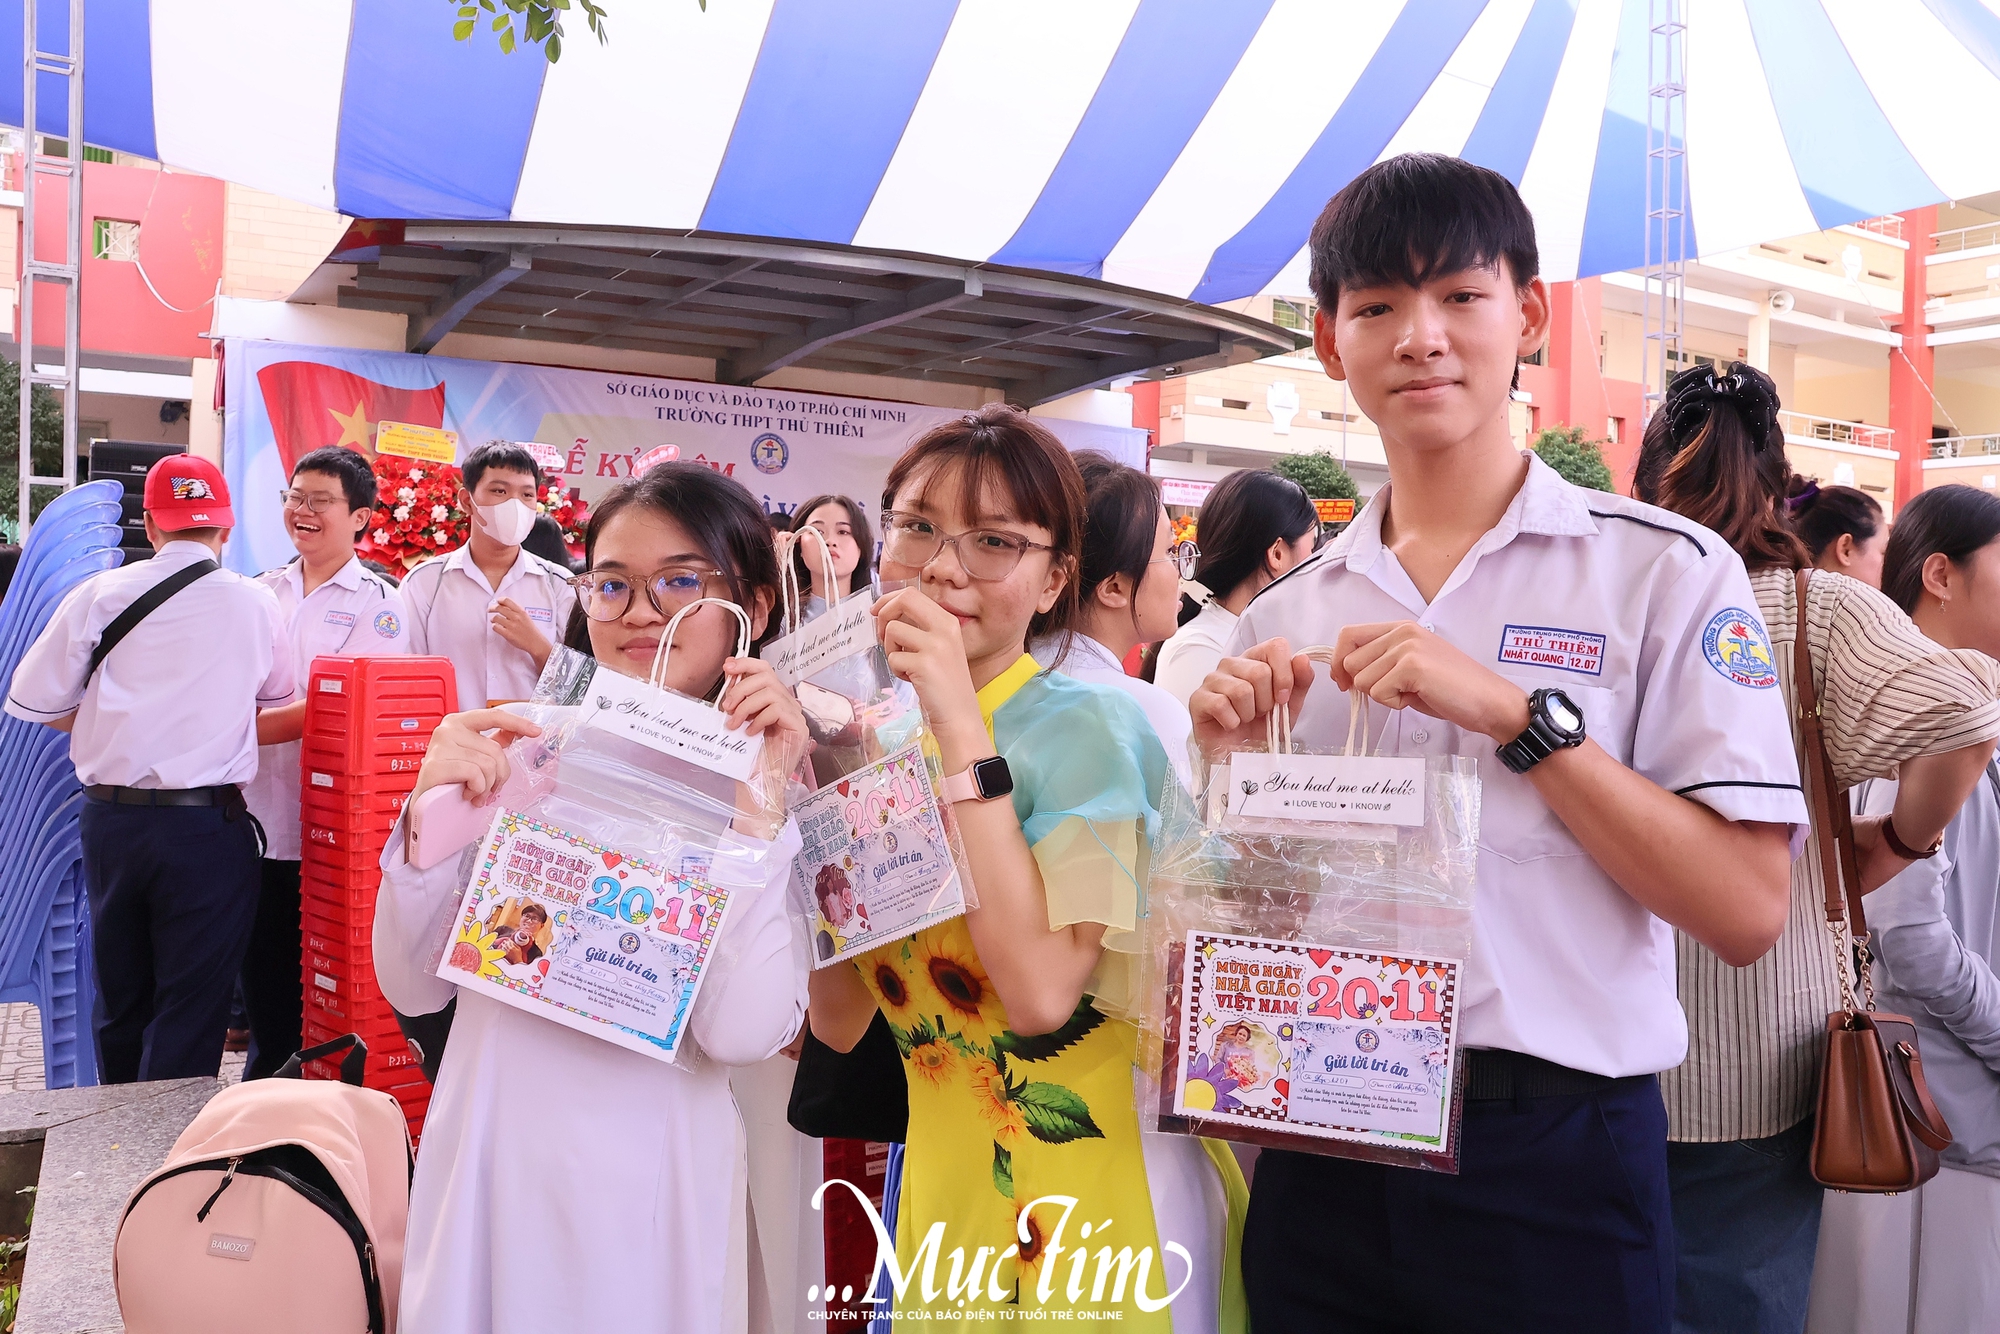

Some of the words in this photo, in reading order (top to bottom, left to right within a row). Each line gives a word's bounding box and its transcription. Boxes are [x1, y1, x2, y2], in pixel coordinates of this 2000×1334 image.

[606, 382, 627, 396] SỞ
[631, 384, 670, 399] GIÁO
[674, 390, 705, 404] DỤC
[708, 390, 728, 405] VÀ
[732, 392, 763, 408] ĐÀO
[766, 398, 796, 413] TẠO
[842, 404, 867, 419] CHÍ
[870, 409, 907, 423] MINH
[654, 406, 727, 426] TRƯỜNG
[731, 413, 773, 430] THPT
[777, 417, 810, 433] THỦ
[813, 420, 864, 439] THIÊM
[528, 444, 556, 456] TRAVEL
[191, 513, 210, 521] USA
[777, 647, 797, 672] You
[800, 635, 818, 657] had
[818, 633, 831, 646] me
[832, 623, 842, 637] at
[843, 611, 866, 633] hello
[1513, 635, 1544, 649] THỦ
[1549, 639, 1600, 656] THIÊM
[1552, 632, 1566, 640] HỌC
[1581, 635, 1602, 643] THÔNG
[796, 660, 810, 672] LOVE
[810, 655, 821, 665] YOU
[829, 640, 847, 653] KNOW
[1503, 649, 1530, 664] NHẬT
[1531, 651, 1564, 665] QUANG
[1570, 657, 1597, 670] 12.07
[1731, 671, 1751, 685] THỦ
[616, 697, 648, 719] You
[651, 710, 682, 730] had
[679, 725, 700, 738] me
[701, 730, 719, 743] at
[715, 738, 748, 755] hello
[641, 727, 660, 740] LOVE
[661, 733, 677, 745] YOU
[691, 745, 715, 759] KNOW
[1263, 771, 1301, 793] You
[1303, 776, 1336, 792] had
[1336, 784, 1358, 793] me
[1361, 781, 1380, 794] at
[1381, 779, 1417, 796] hello
[1296, 800, 1318, 808] LOVE
[1319, 801, 1337, 809] YOU
[1355, 803, 1383, 811] KNOW
[513, 839, 555, 862] MỪNG
[555, 854, 593, 877] NGÀY
[887, 857, 899, 872] lời
[899, 852, 911, 866] tri
[911, 850, 924, 863] ân
[507, 853, 543, 875] NHÀ
[545, 863, 587, 892] GIÁO
[506, 869, 543, 893] VIỆT
[543, 882, 581, 906] NAM
[585, 946, 608, 964] Gửi
[608, 952, 625, 968] lời
[626, 959, 642, 975] tri
[641, 968, 658, 984] ân
[1215, 960, 1260, 977] MỪNG
[1262, 961, 1303, 980] NGÀY
[1214, 975, 1251, 992] NHÀ
[1255, 978, 1301, 998] GIÁO
[1215, 992, 1255, 1012] VIỆT
[1258, 998, 1299, 1015] NAM
[1324, 1054, 1349, 1072] Gửi
[1350, 1055, 1369, 1070] lời
[1370, 1058, 1389, 1073] tri
[1389, 1061, 1410, 1078] ân
[211, 1239, 248, 1253] BAMOZO
